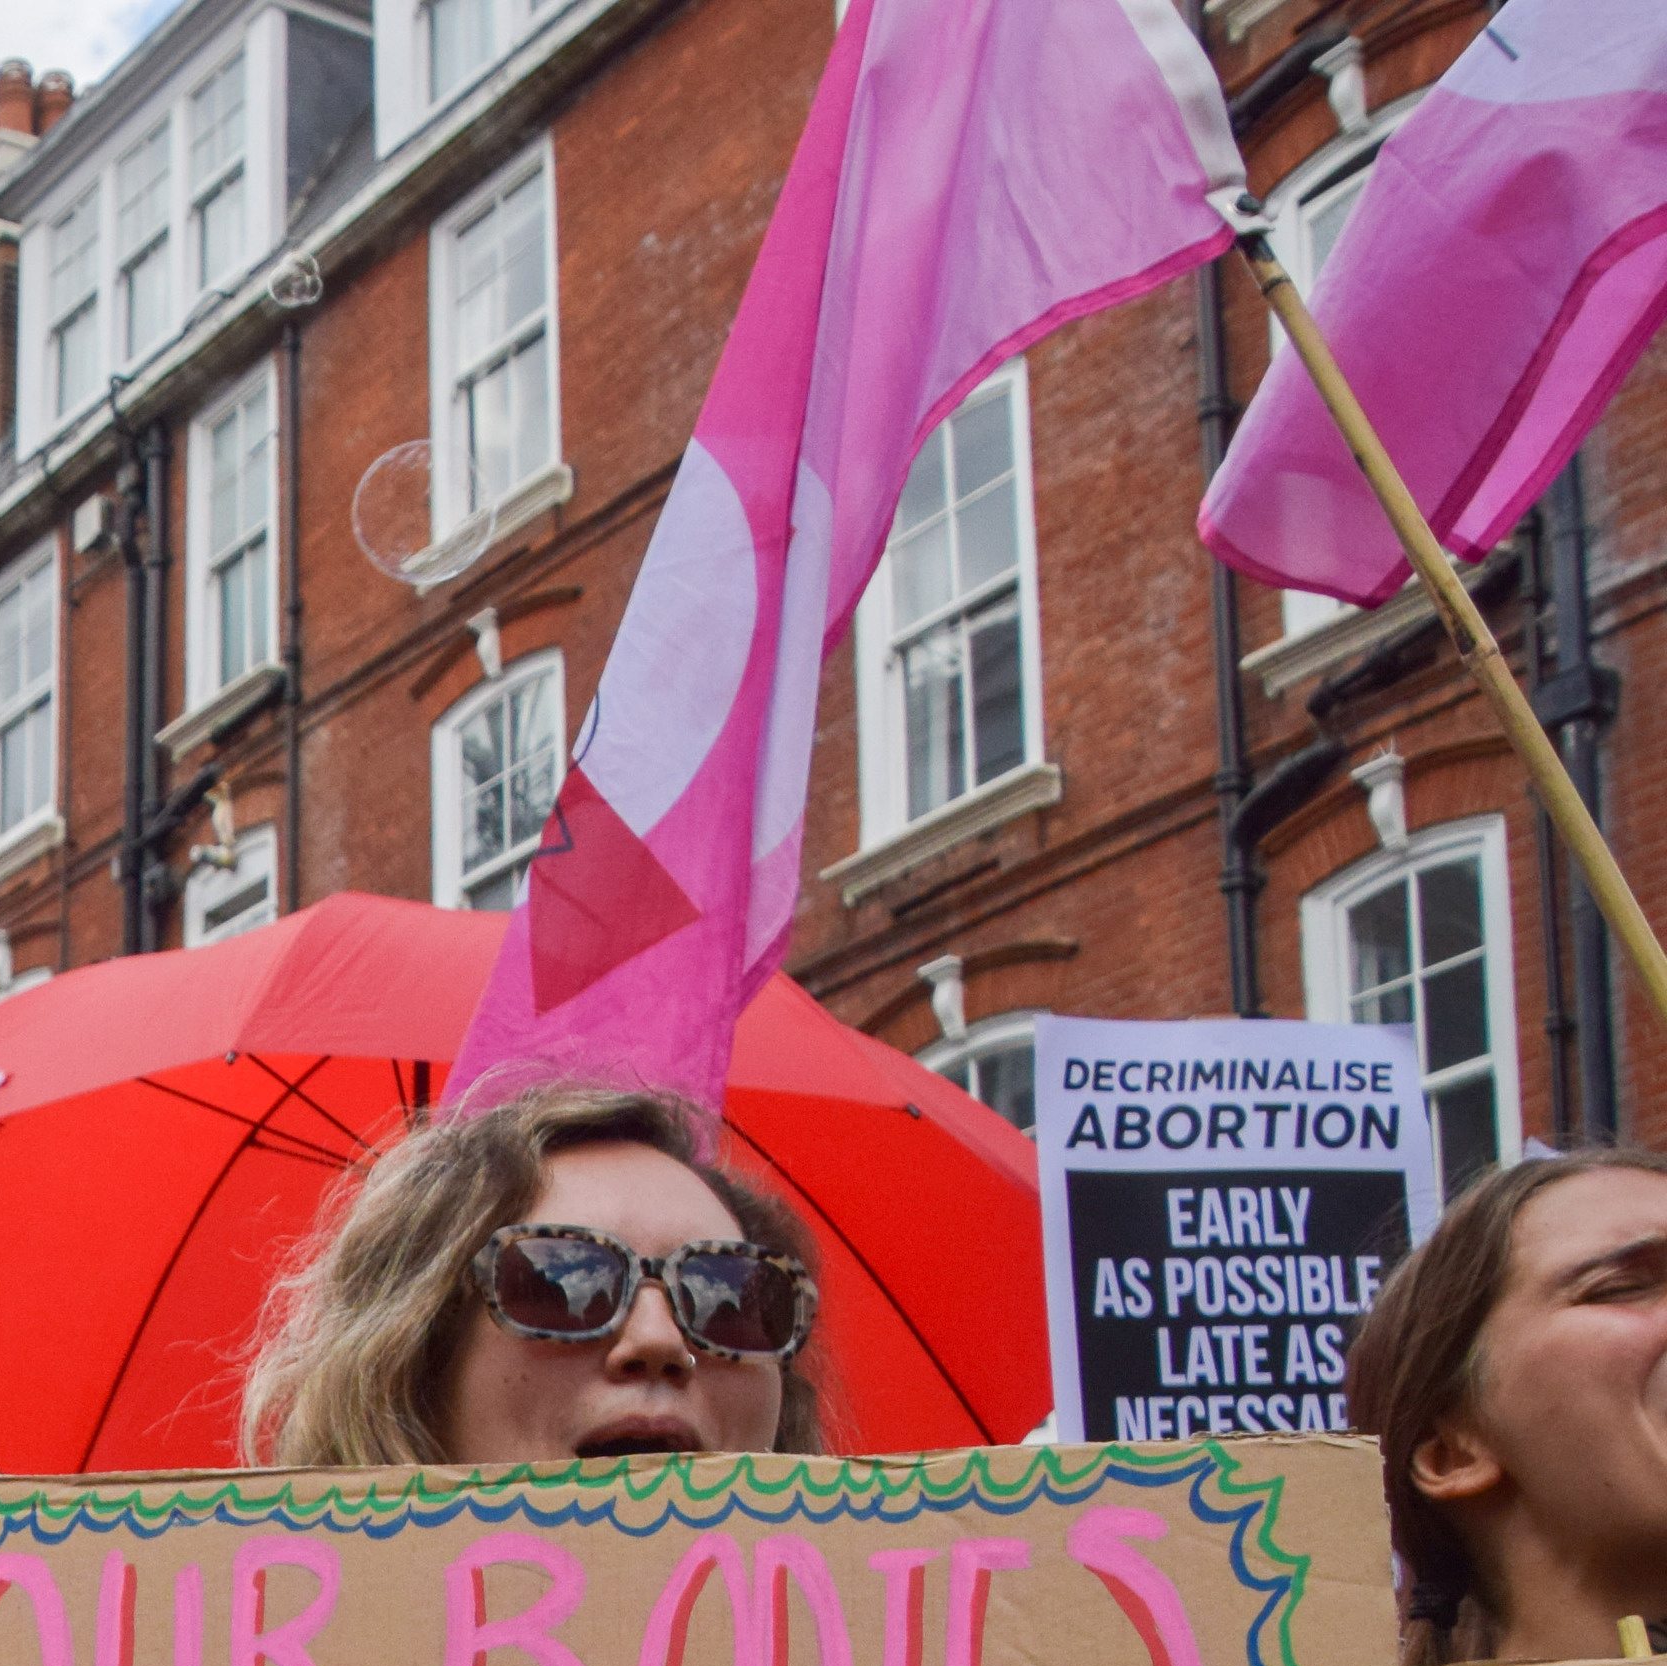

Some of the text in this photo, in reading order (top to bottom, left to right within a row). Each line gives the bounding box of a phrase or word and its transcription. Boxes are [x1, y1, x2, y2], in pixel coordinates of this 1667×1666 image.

[1064, 1058, 1393, 1093] DECRIMINALISE
[1065, 1102, 1400, 1150] ABORTION
[1167, 1187, 1312, 1248] EARLY
[1094, 1255, 1383, 1319] AS POSSIBLE
[1157, 1323, 1346, 1386] LATE AS
